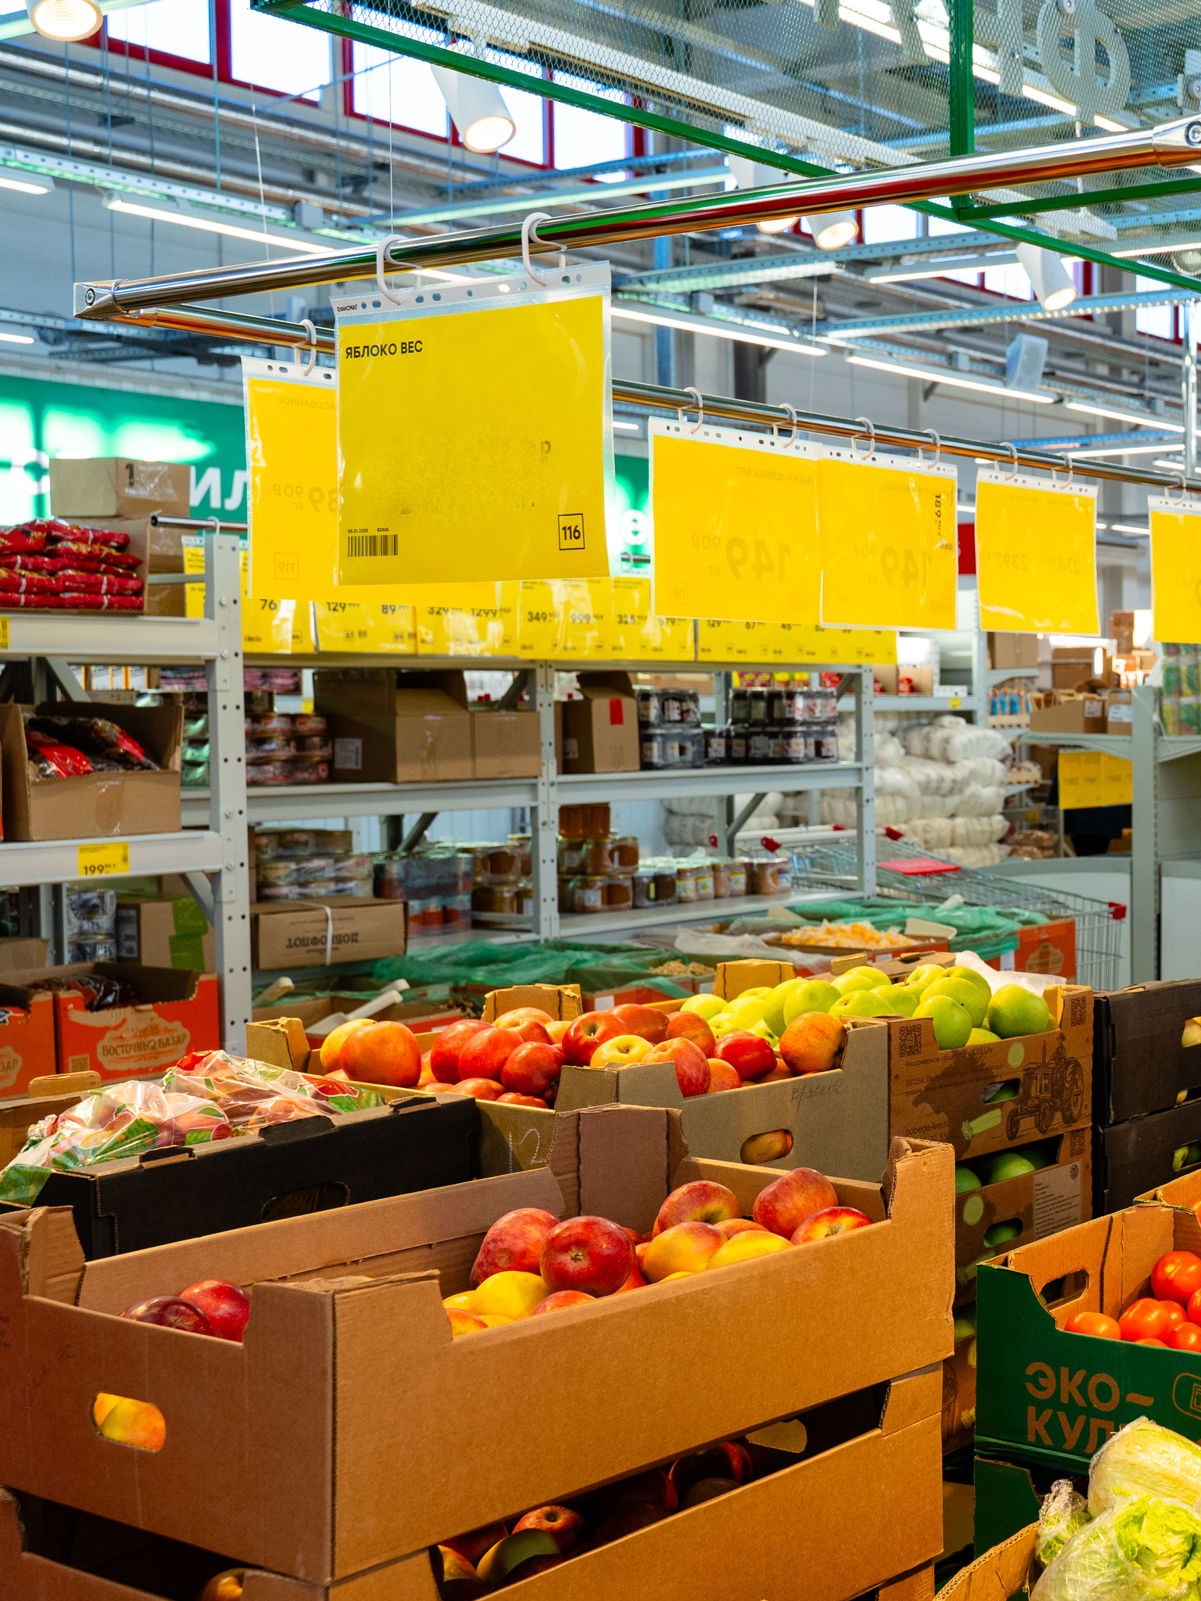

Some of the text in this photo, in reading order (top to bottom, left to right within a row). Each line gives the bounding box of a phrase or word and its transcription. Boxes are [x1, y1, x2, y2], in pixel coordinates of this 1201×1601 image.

[345, 340, 423, 359] ЯБЛОКО ВЕС
[561, 525, 581, 540] 116
[260, 599, 277, 611] 76
[326, 601, 347, 612] 129
[527, 611, 547, 623] 349
[83, 864, 104, 876] 199
